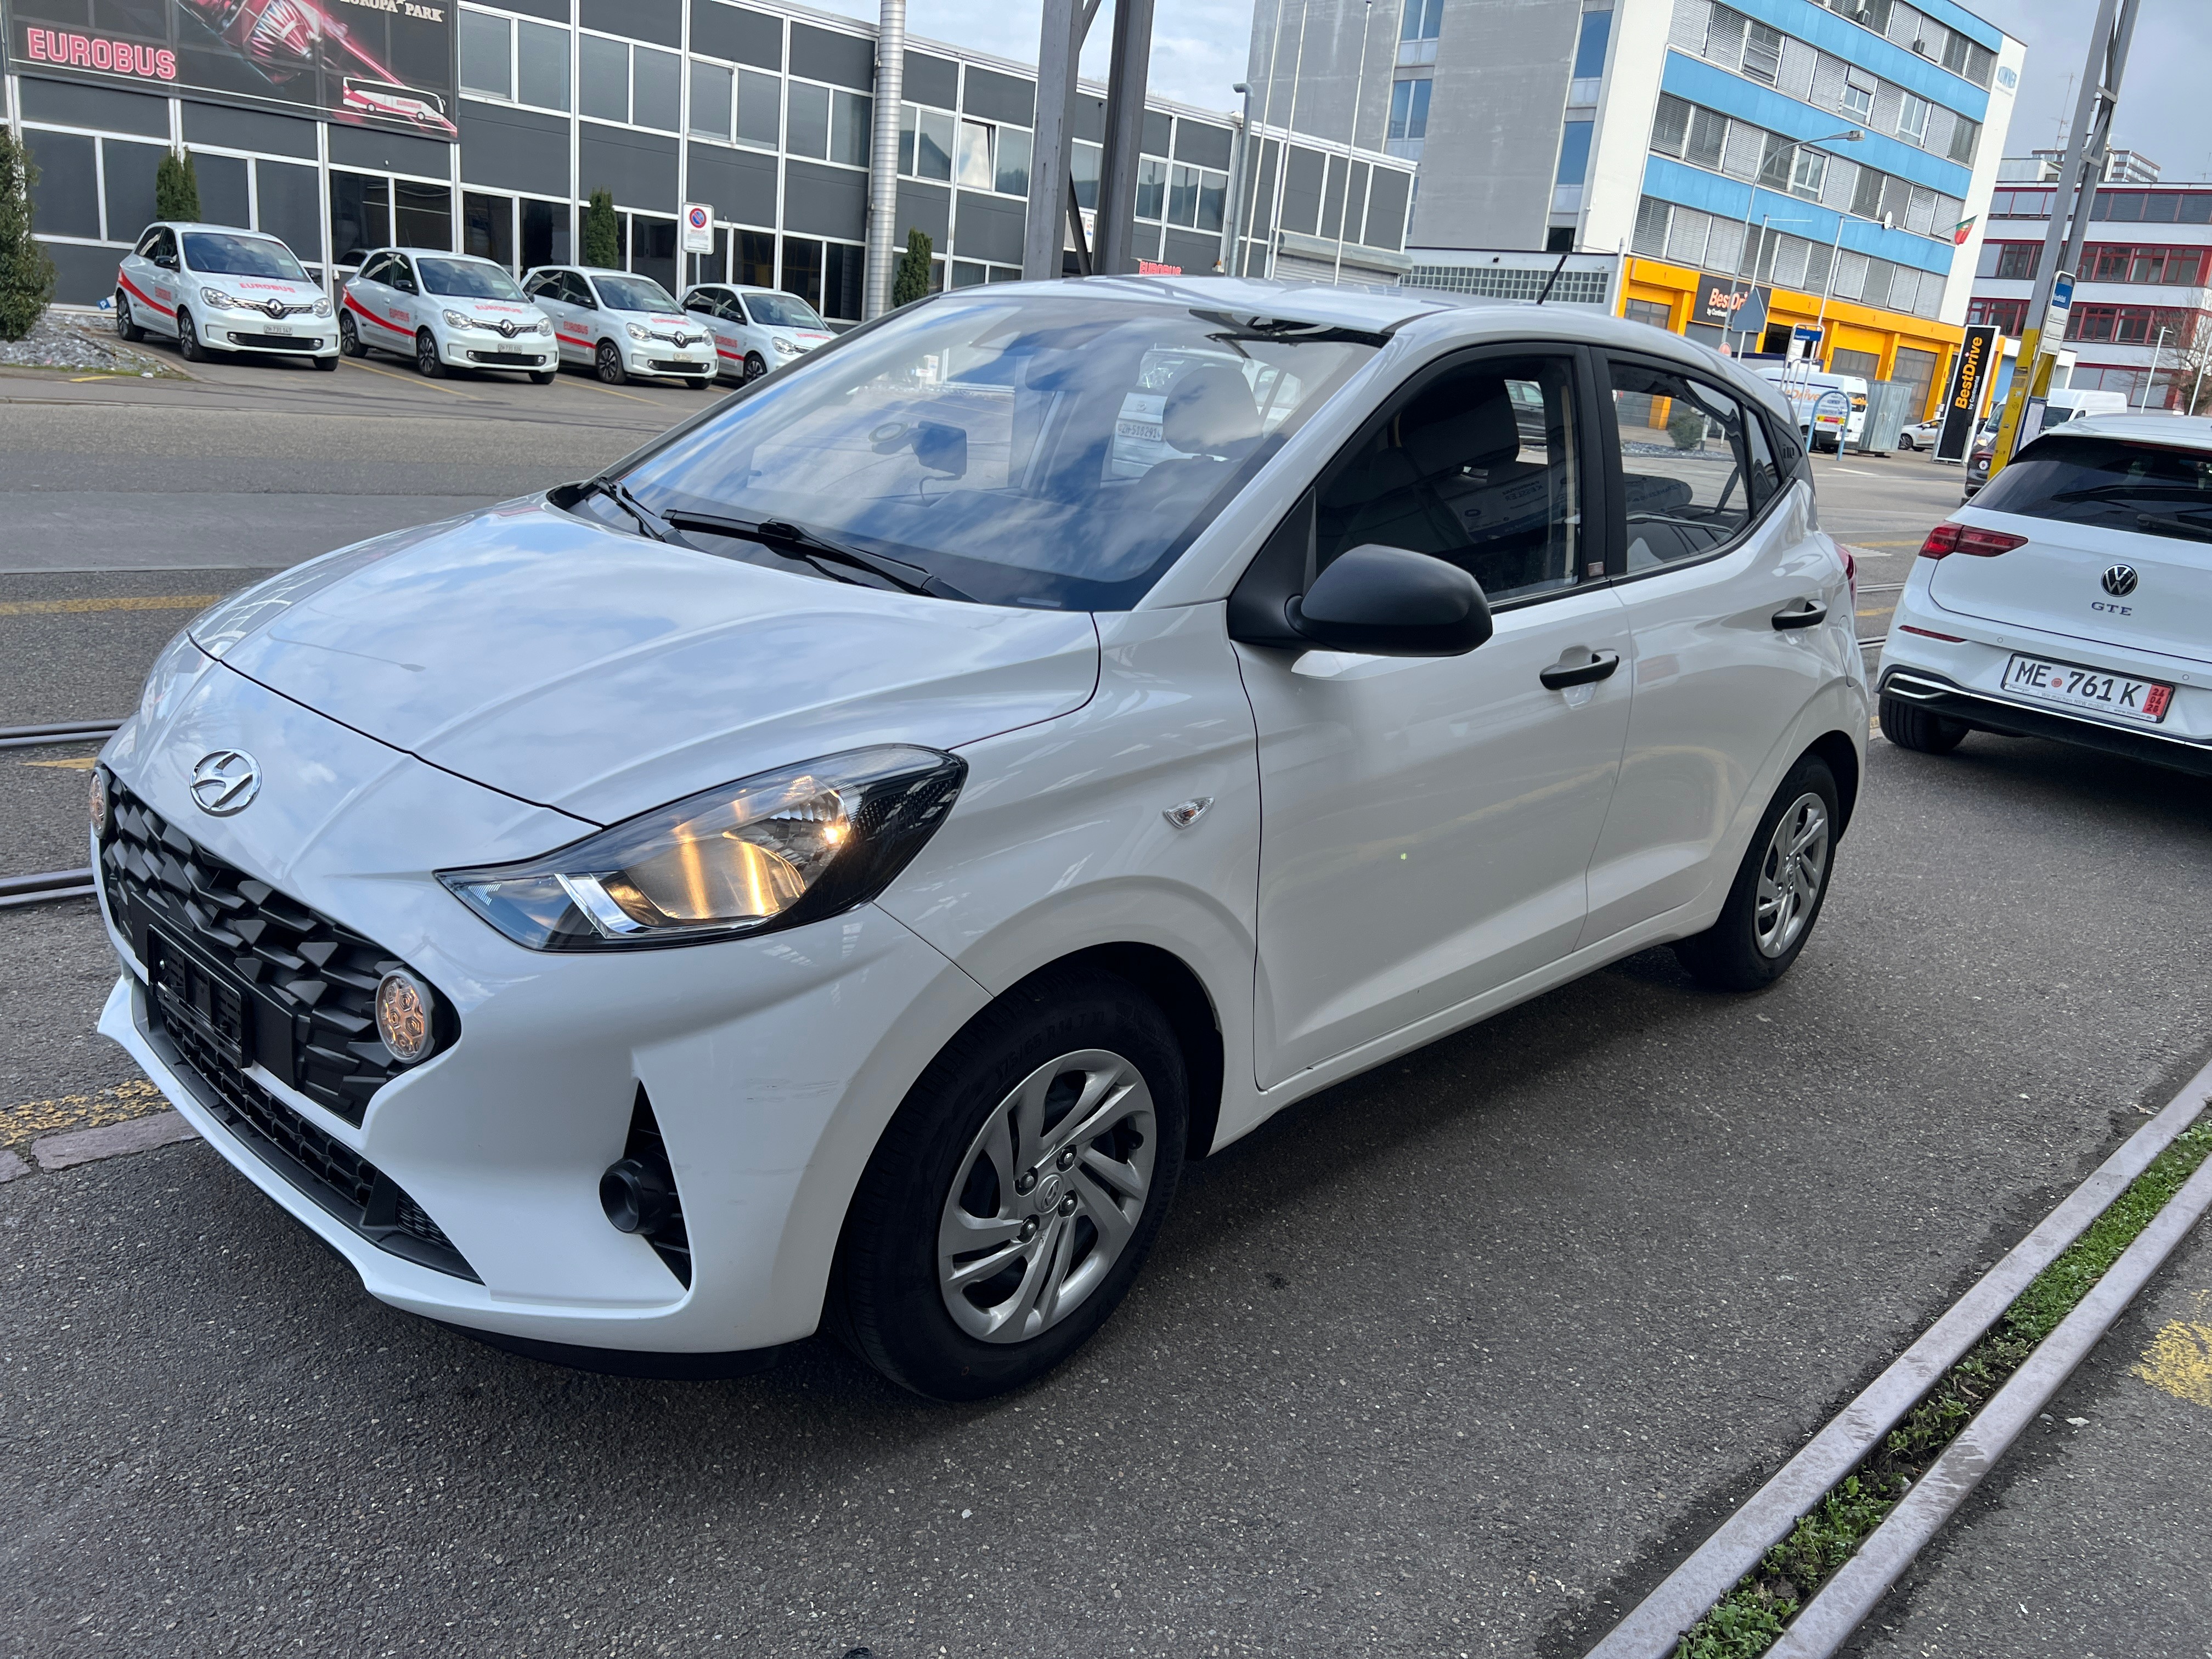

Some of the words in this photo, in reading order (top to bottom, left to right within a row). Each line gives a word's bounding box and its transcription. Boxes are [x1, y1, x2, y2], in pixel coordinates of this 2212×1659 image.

[405, 3, 443, 22] PARK
[27, 27, 176, 80] EUROBUS
[239, 282, 295, 294] EUROBUS
[1954, 336, 1983, 409] BestDrive
[2091, 601, 2132, 616] GTE
[2015, 661, 2052, 688] ME
[2066, 671, 2114, 702] 761
[2119, 682, 2142, 708] K
